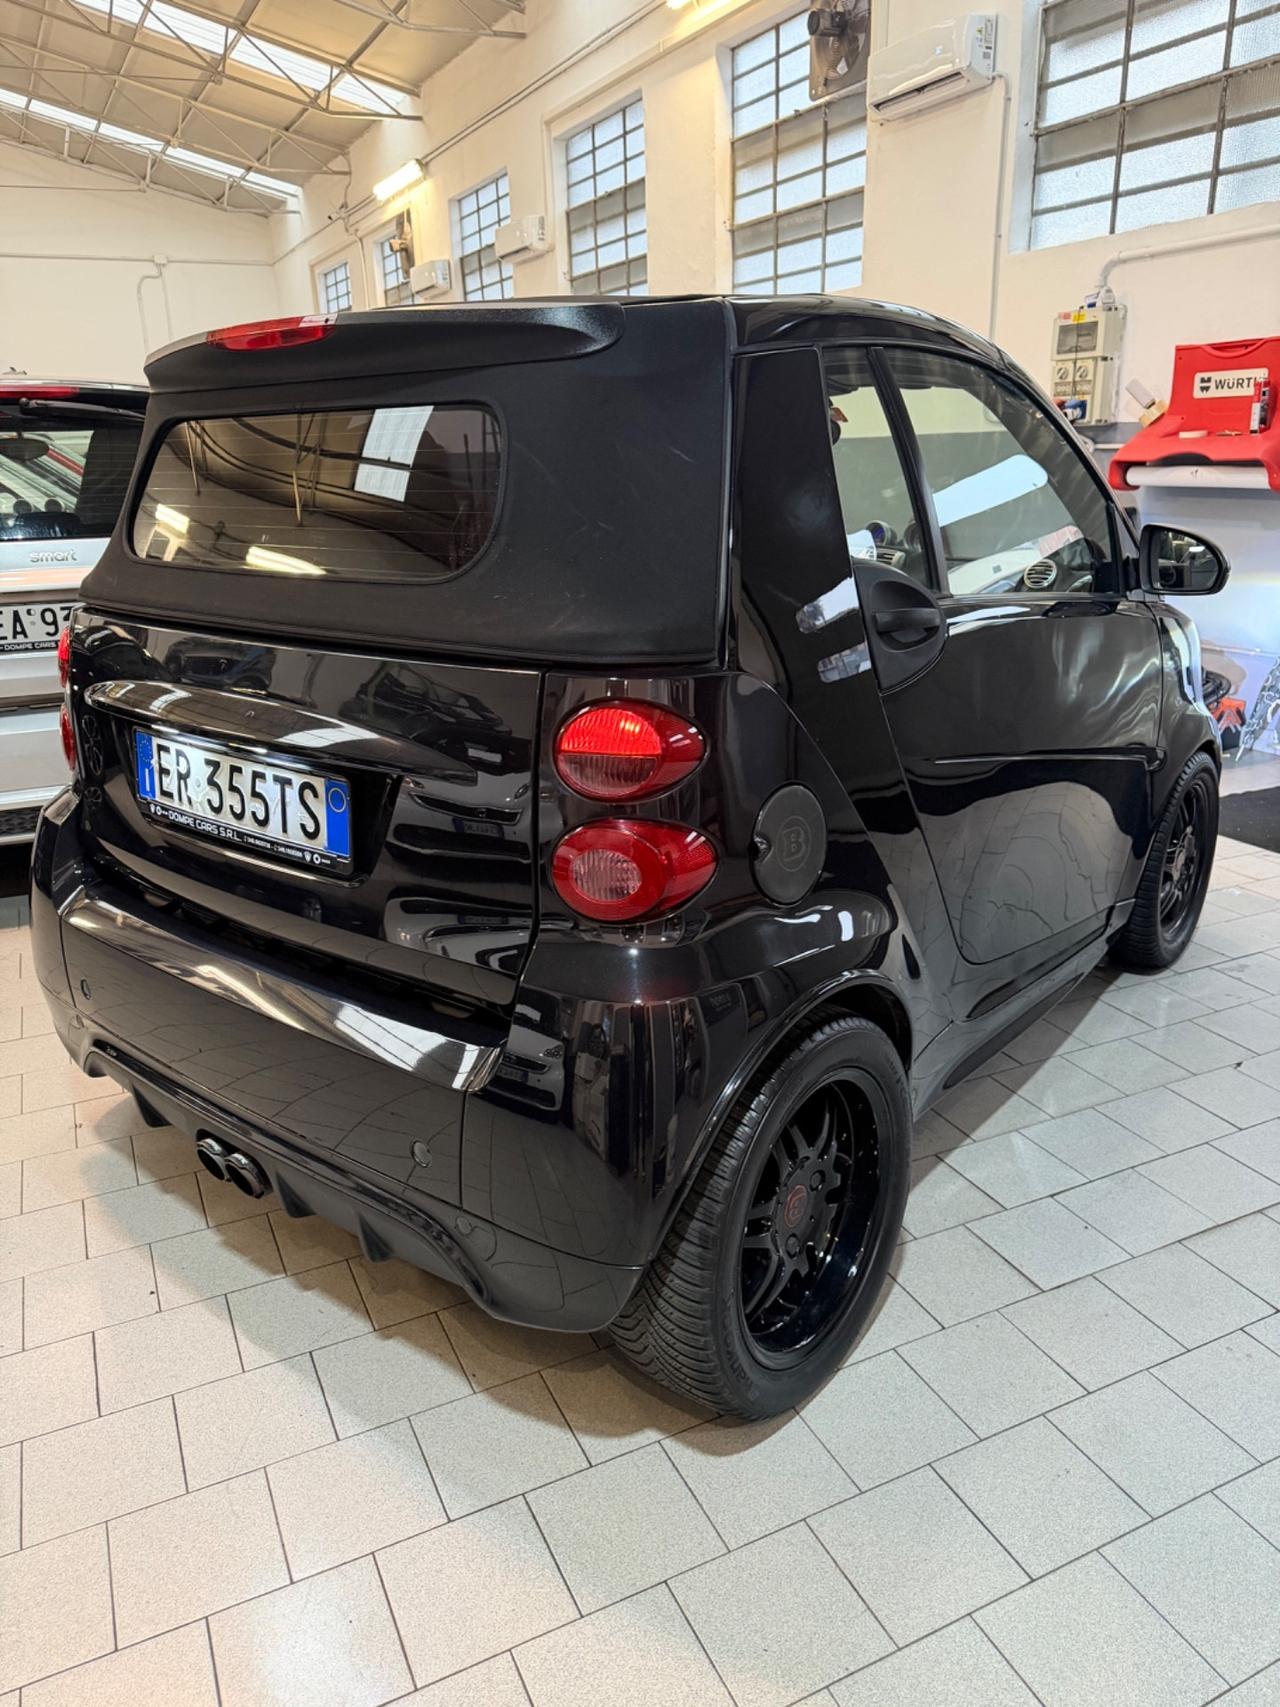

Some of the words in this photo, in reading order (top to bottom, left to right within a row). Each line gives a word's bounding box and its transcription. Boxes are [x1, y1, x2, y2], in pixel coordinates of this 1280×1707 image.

[1214, 376, 1257, 390] WÜRT
[30, 550, 77, 563] smart
[168, 811, 195, 828] DOMPE
[195, 819, 219, 836] CARS
